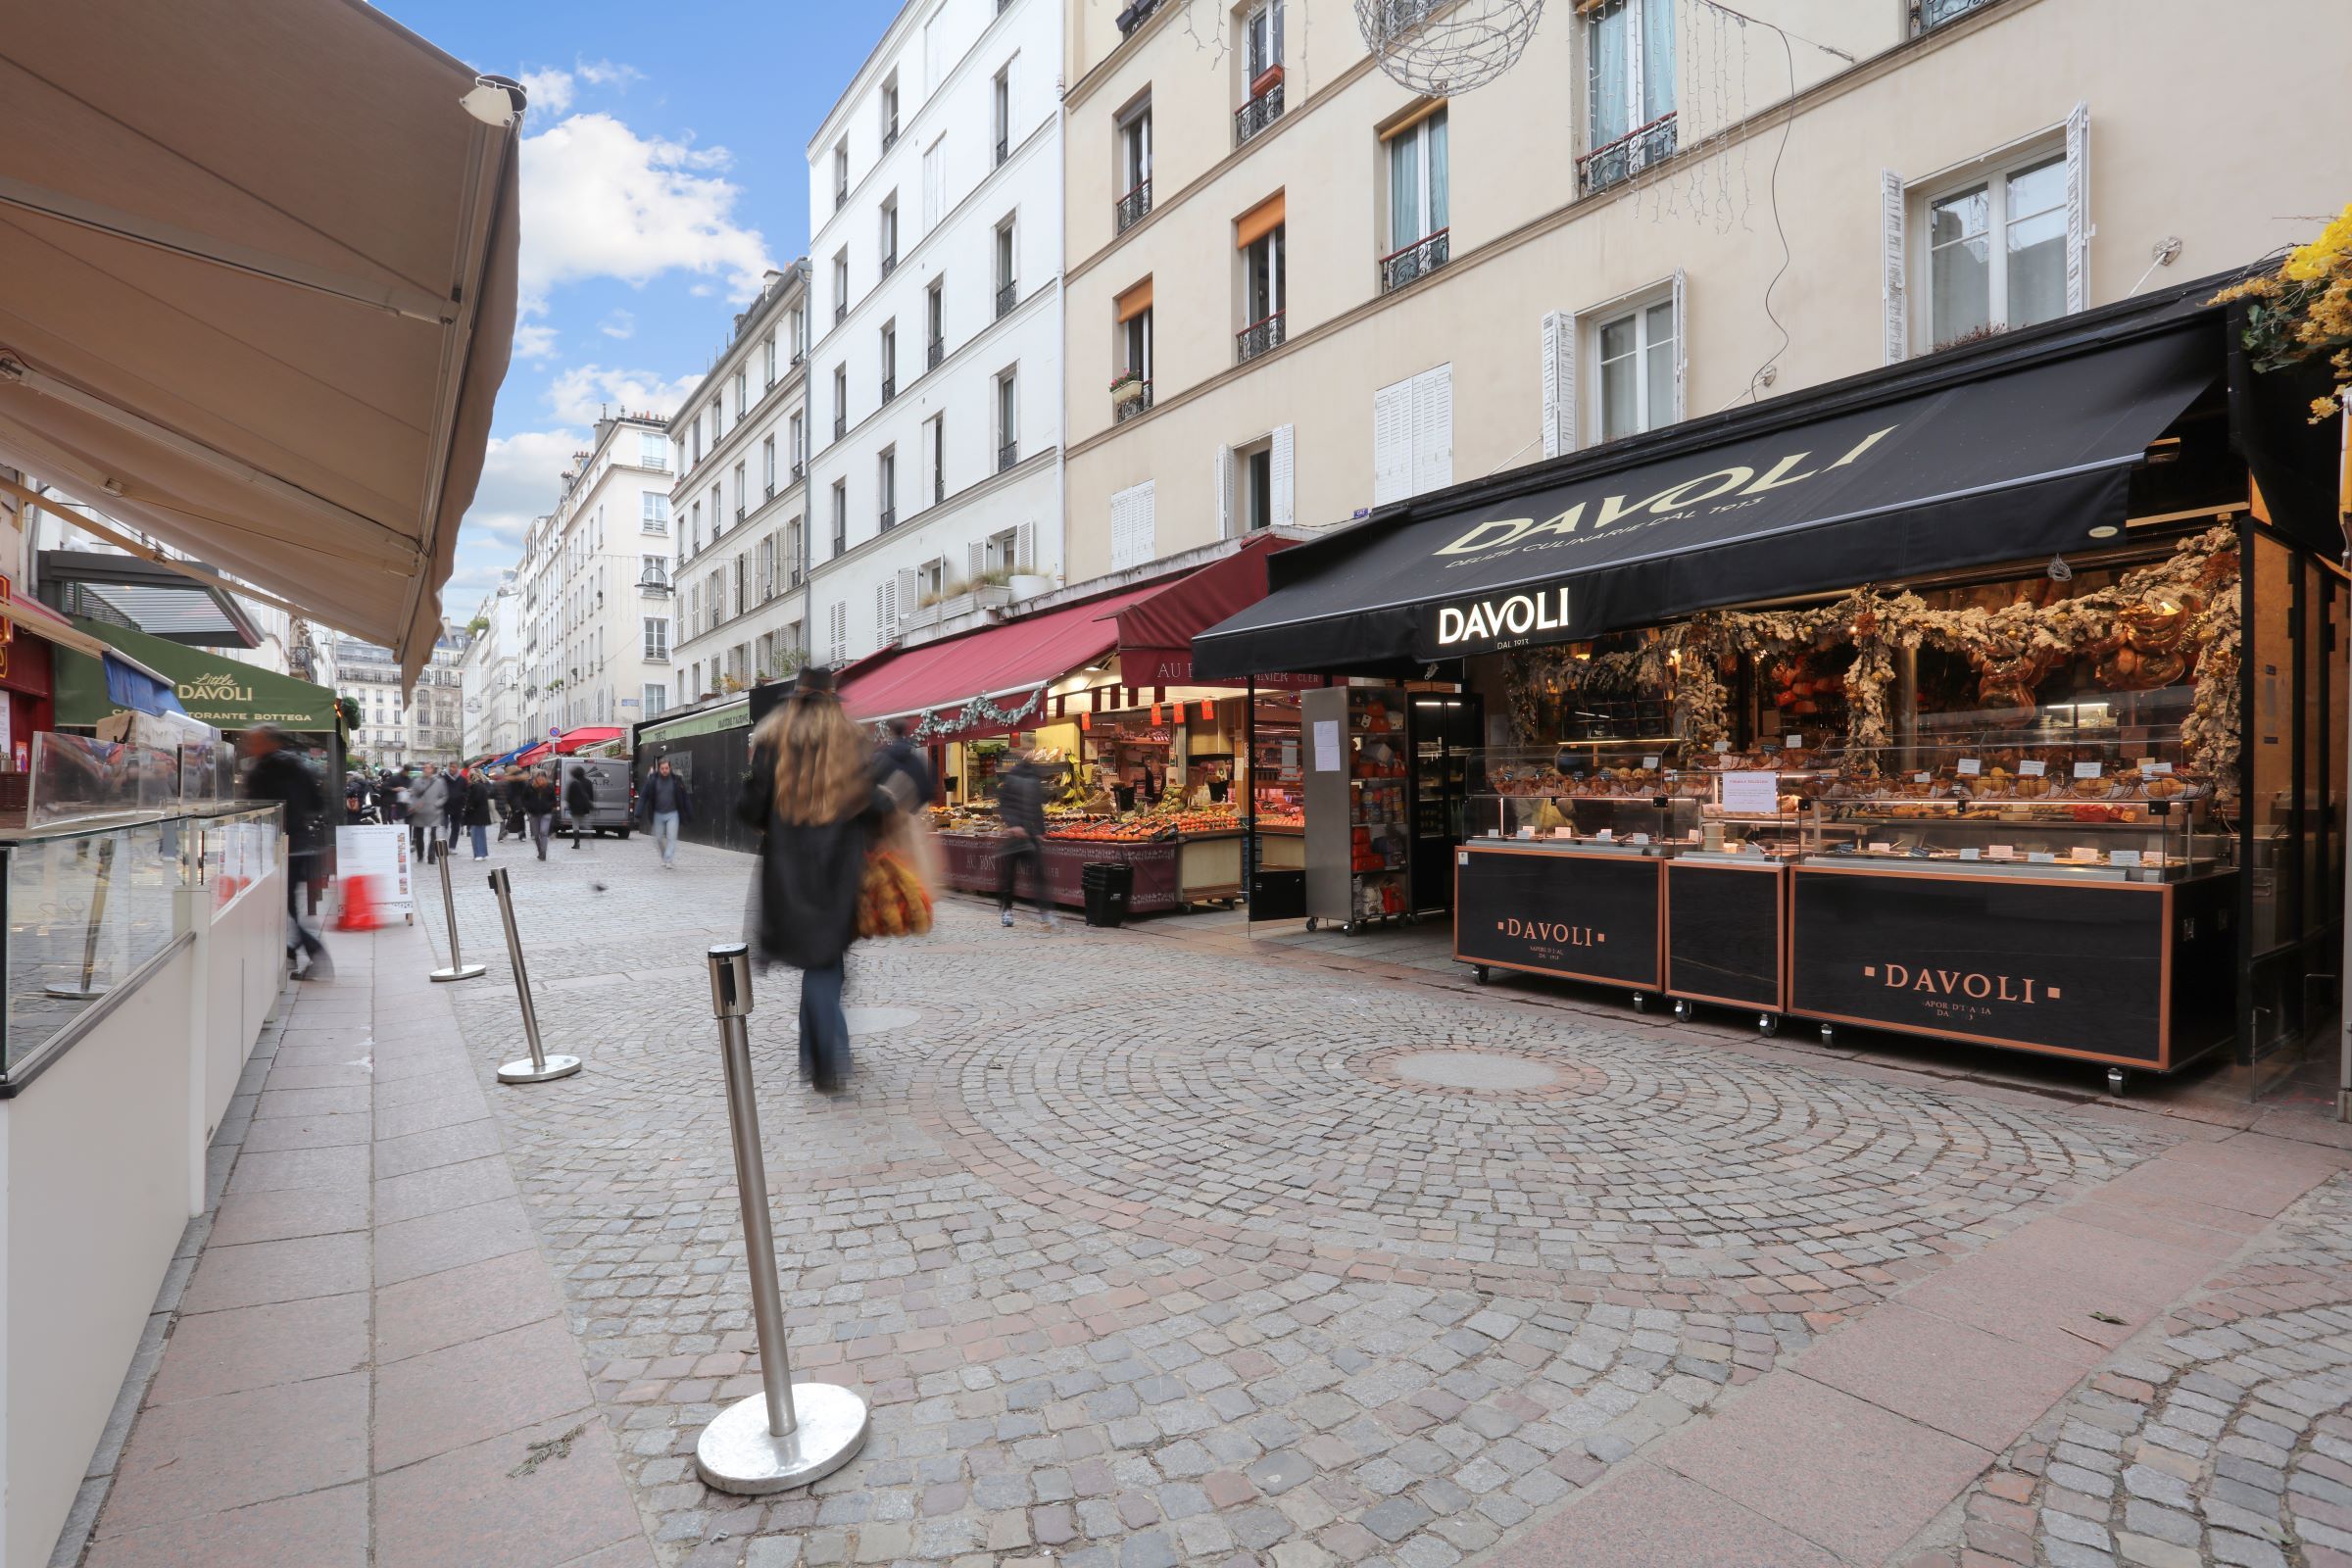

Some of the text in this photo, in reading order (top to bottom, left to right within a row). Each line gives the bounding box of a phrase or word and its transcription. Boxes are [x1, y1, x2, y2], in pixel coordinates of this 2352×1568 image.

[1432, 423, 1899, 556] DAVOLI
[1522, 522, 1645, 552] CULINARIE
[1646, 510, 1696, 527] DAL
[1708, 496, 1766, 514] 1913
[1439, 587, 1569, 645] DAVOLI
[1496, 641, 1512, 650] DAL
[1156, 662, 1181, 678] AU
[1297, 673, 1319, 683] CLER
[191, 672, 237, 687] Little
[177, 684, 253, 702] DAVOLI
[186, 711, 313, 722] TORANTE BOTTEGA
[1506, 917, 1592, 947] DAVOLI
[1884, 963, 2035, 1004] DAVOLI
[1922, 1000, 1950, 1010] APOR
